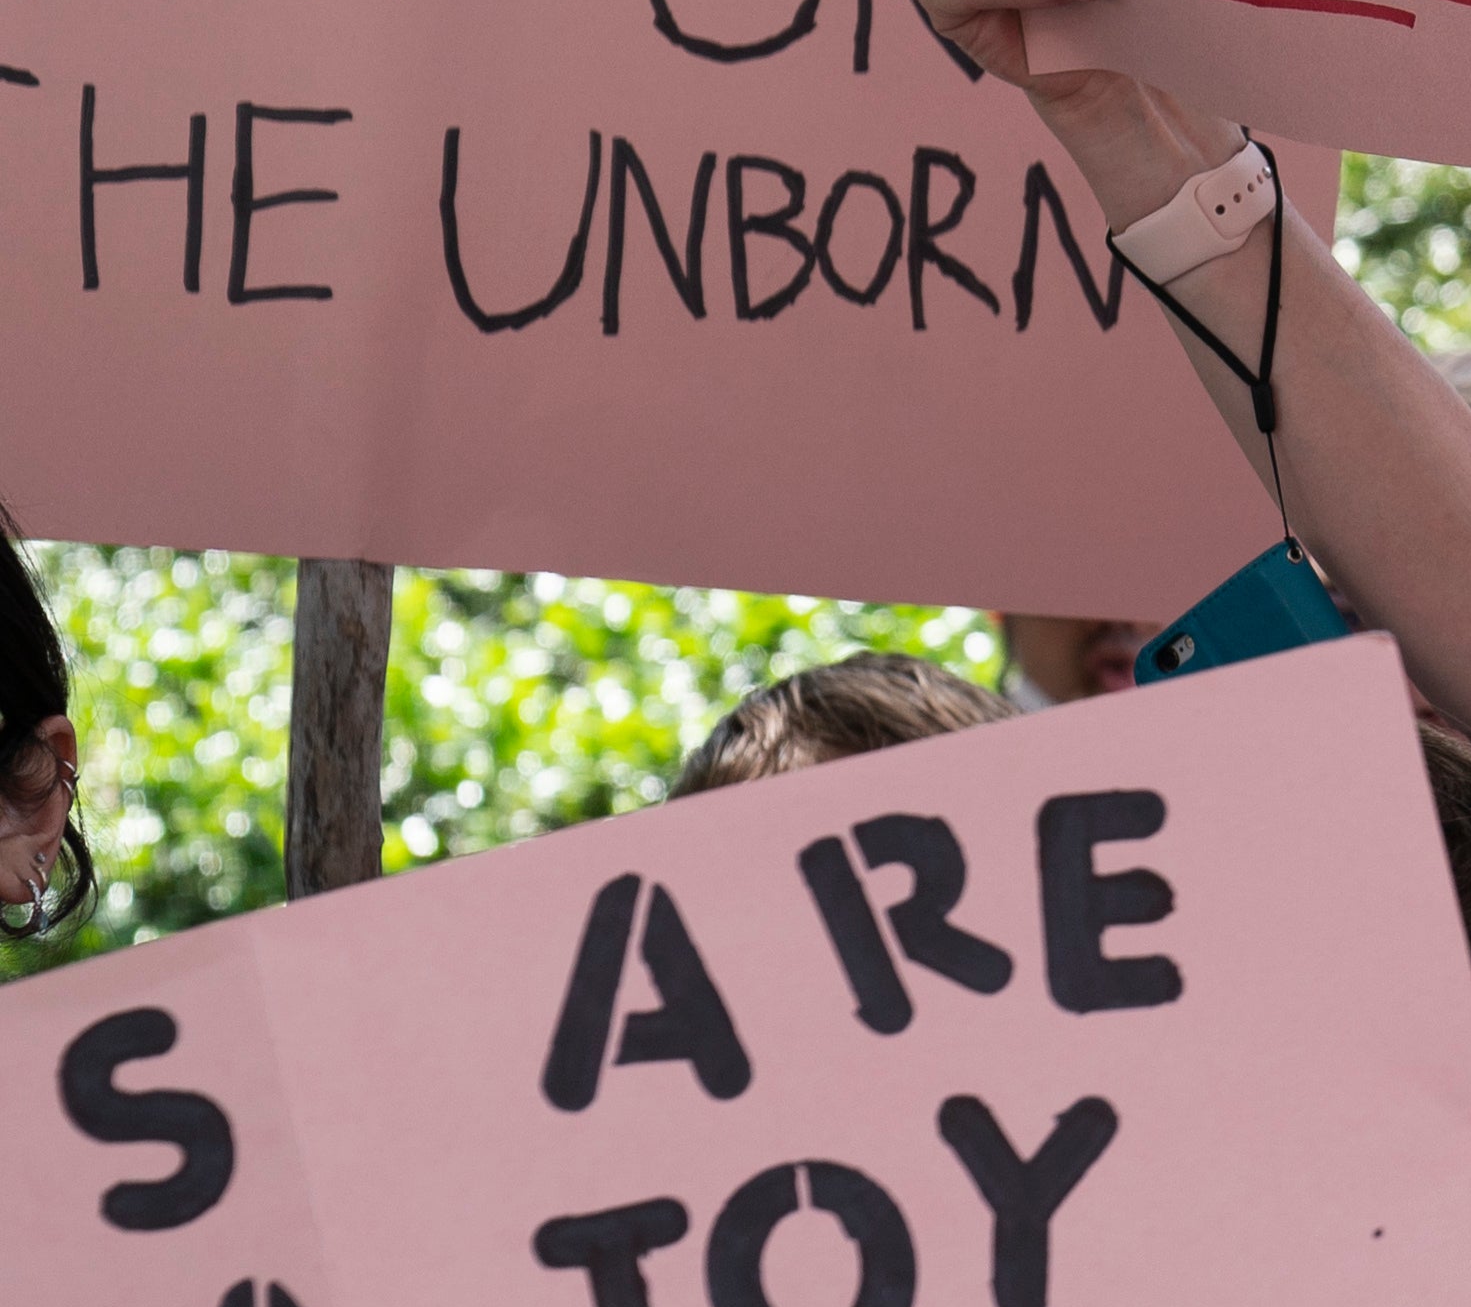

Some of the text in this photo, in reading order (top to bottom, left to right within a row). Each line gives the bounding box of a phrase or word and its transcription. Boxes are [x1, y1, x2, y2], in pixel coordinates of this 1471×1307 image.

[0, 65, 1127, 336] HE UNBORN
[58, 788, 1184, 1232] S ARE
